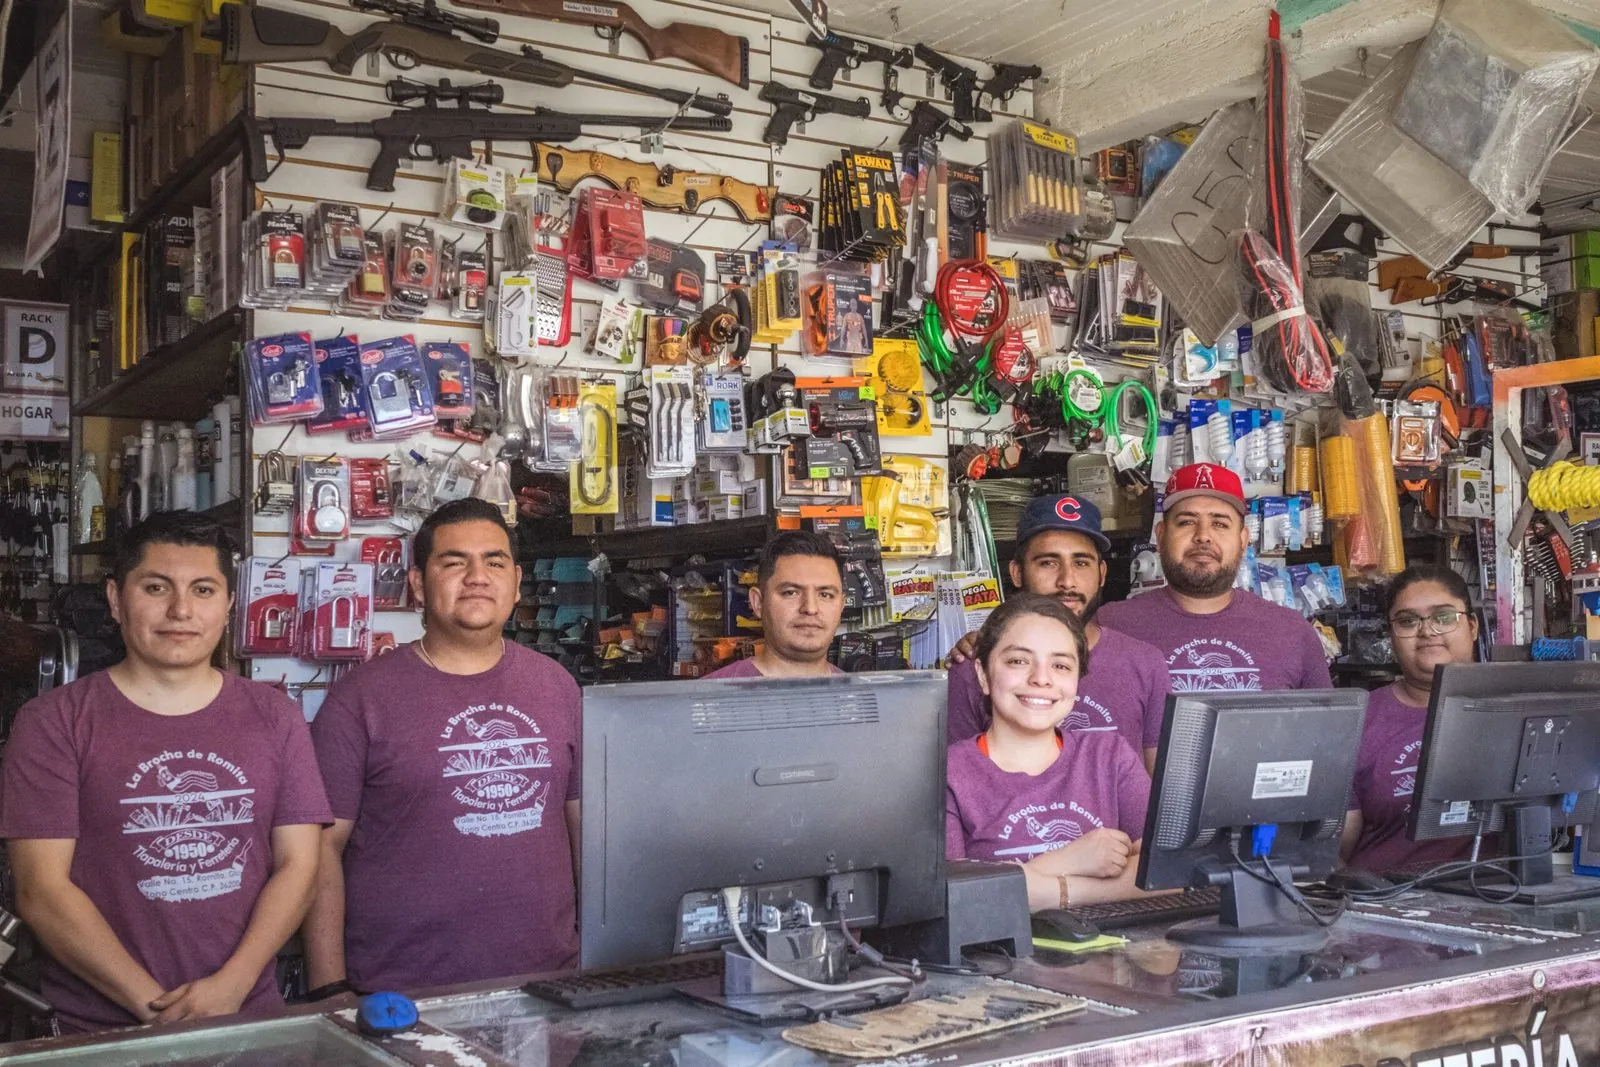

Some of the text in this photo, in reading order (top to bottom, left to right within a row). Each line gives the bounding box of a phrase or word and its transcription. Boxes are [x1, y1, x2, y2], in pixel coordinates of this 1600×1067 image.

[952, 171, 980, 183] TRUPER
[267, 220, 295, 229] Master
[21, 312, 53, 324] RACK
[20, 326, 56, 364] D
[2, 405, 53, 419] HOGAR
[1194, 464, 1215, 489] A
[1055, 497, 1083, 521] C
[893, 579, 913, 588] PEGA
[963, 584, 987, 596] PEGA
[964, 589, 999, 607] RATA
[1166, 638, 1255, 665] La Brocha de Romita
[1083, 695, 1113, 723] Romita
[441, 702, 540, 739] La Brocha de Romita
[483, 740, 508, 750] 2024
[1395, 740, 1422, 764] La Bro
[126, 749, 248, 789] La Brocha de Romita
[478, 773, 518, 786] DESDE
[175, 793, 206, 803] 2024
[485, 784, 513, 799] 1950
[497, 802, 504, 812] y
[482, 823, 506, 831] Centro
[998, 801, 1105, 840] La Brocha de Romit
[165, 829, 213, 847] DESDE
[174, 842, 208, 860] 1950
[190, 862, 197, 874] y
[139, 878, 161, 889] Valle
[145, 889, 167, 898] Zona
[169, 886, 199, 896] Centro
